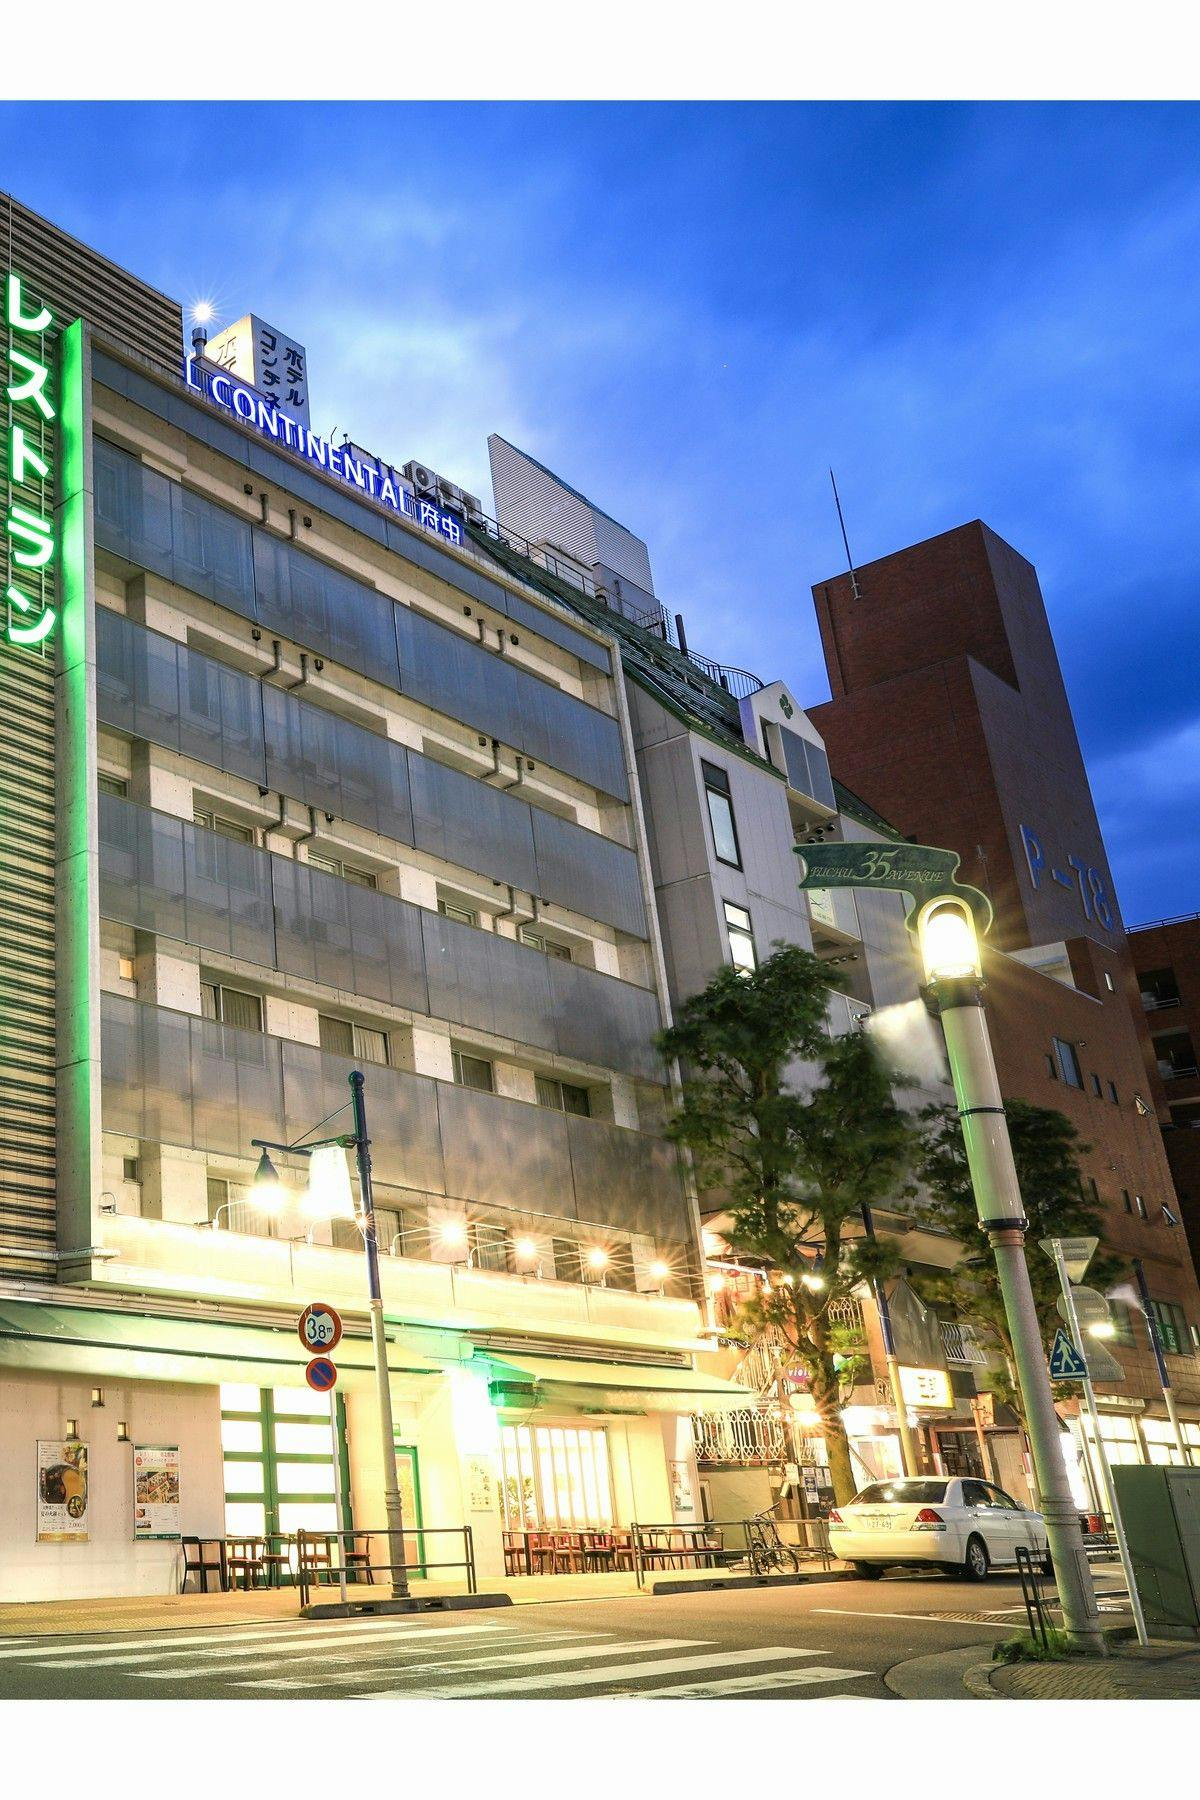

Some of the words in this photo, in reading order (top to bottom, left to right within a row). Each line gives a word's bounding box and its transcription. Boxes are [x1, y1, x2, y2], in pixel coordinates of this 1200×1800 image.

[283, 347, 305, 407] ホテル
[5, 273, 57, 645] レストラン
[211, 375, 414, 518] CONTINENTAL
[420, 501, 461, 546] 府中
[852, 849, 900, 881] 35
[885, 869, 945, 883] AVENUE
